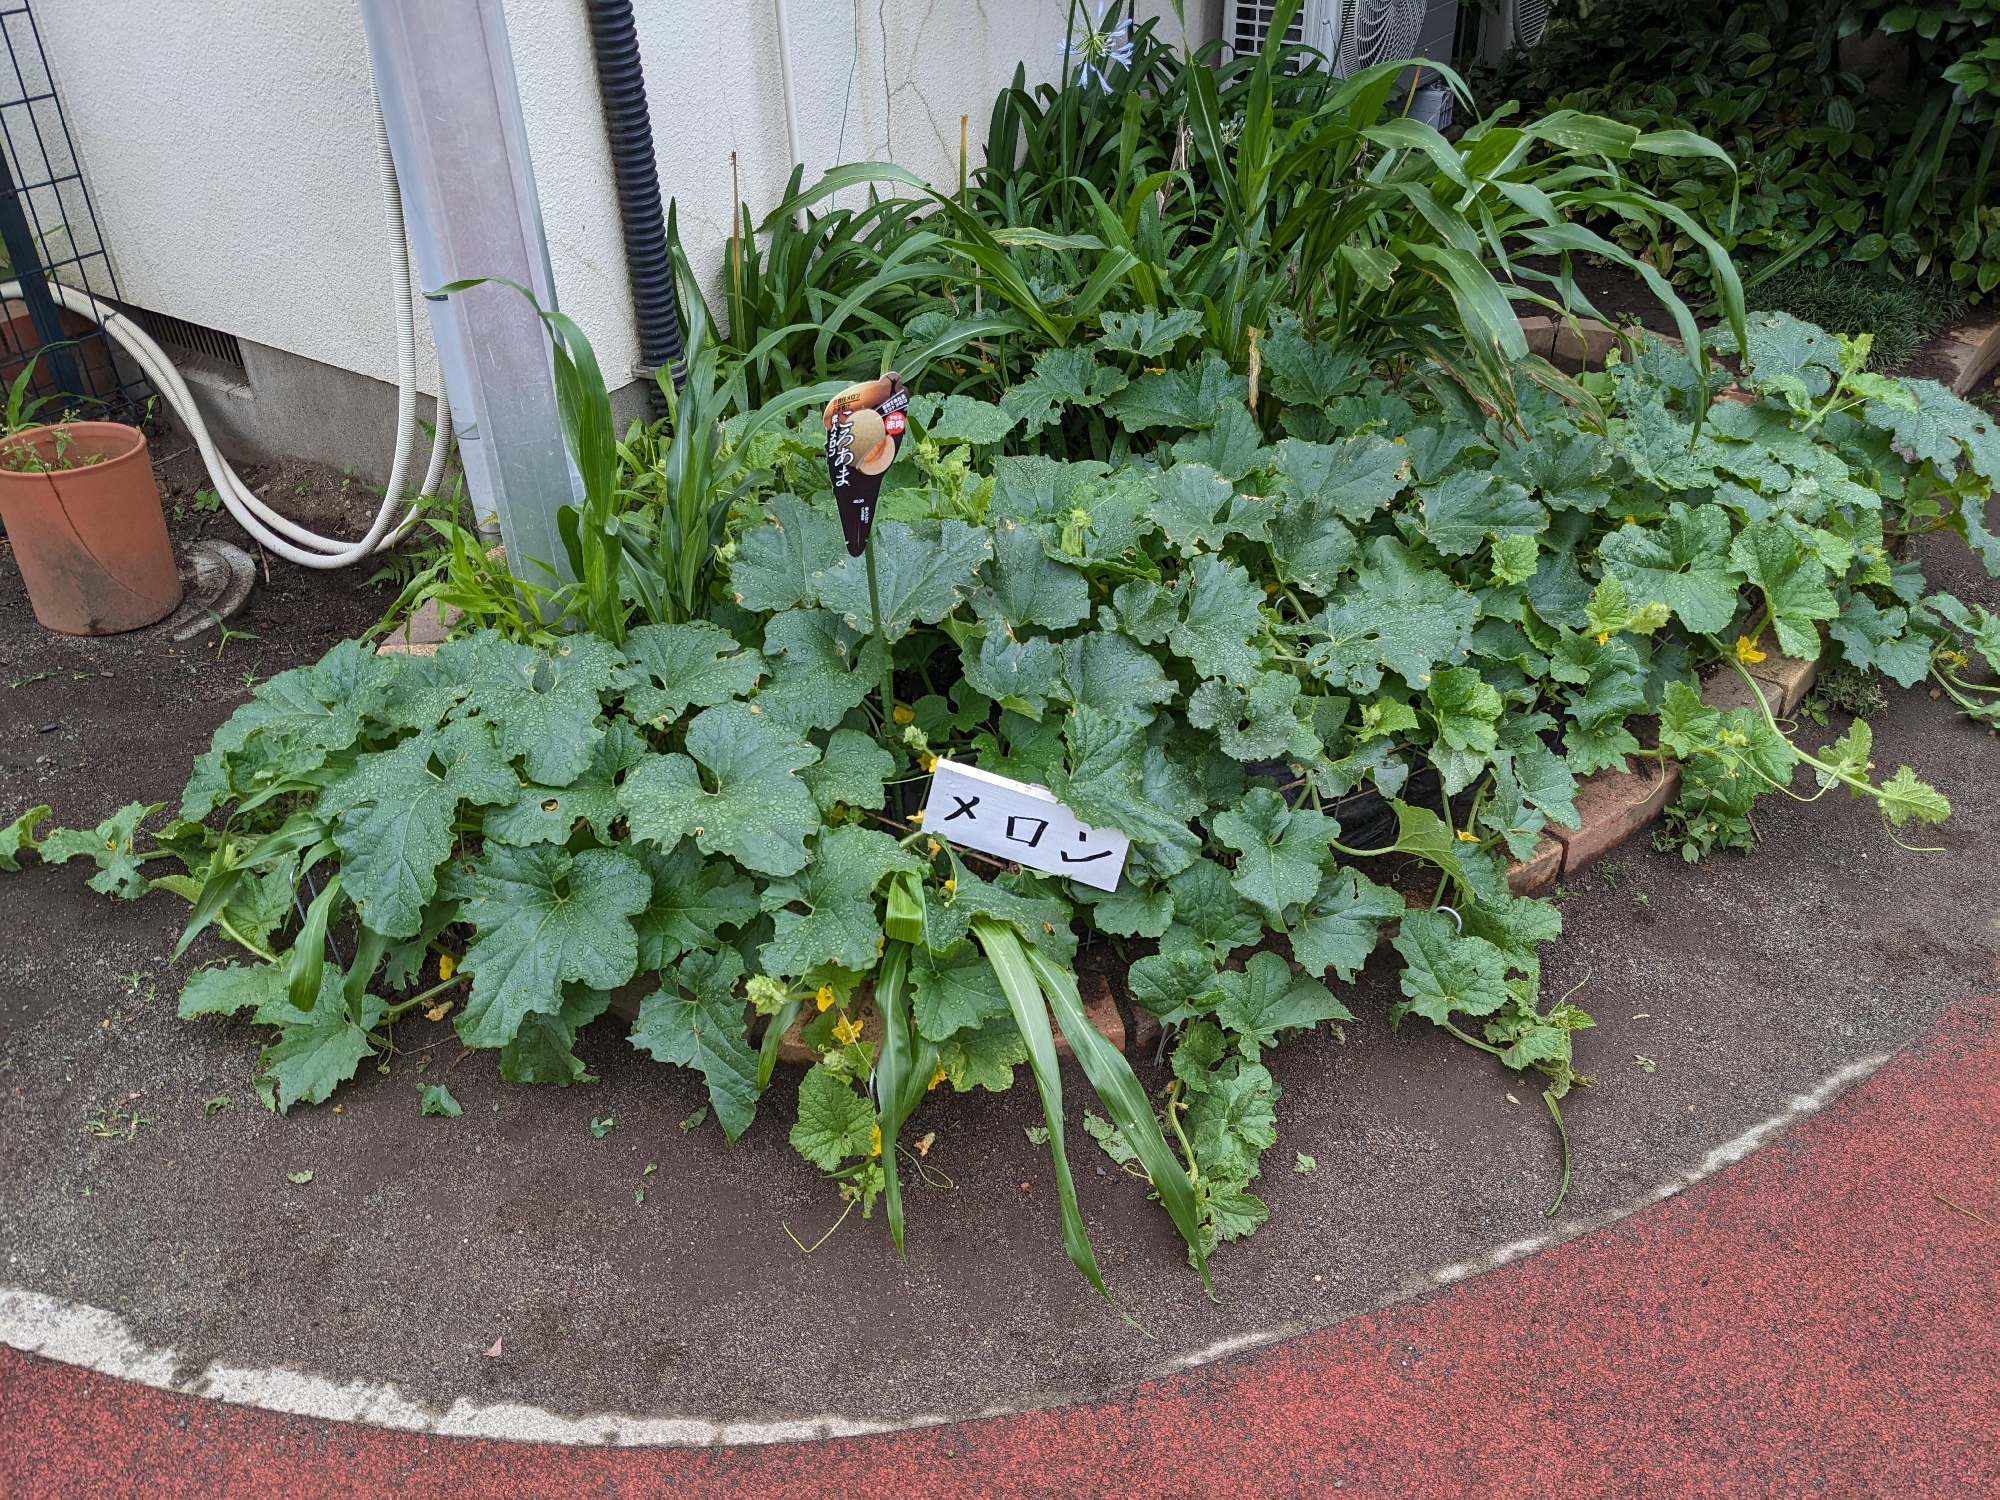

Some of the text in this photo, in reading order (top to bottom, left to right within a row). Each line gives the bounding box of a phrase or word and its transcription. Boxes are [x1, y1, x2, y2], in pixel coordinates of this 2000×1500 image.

[835, 410, 854, 486] ころあま
[886, 420, 904, 430] 赤肉
[943, 796, 1114, 862] メロン
